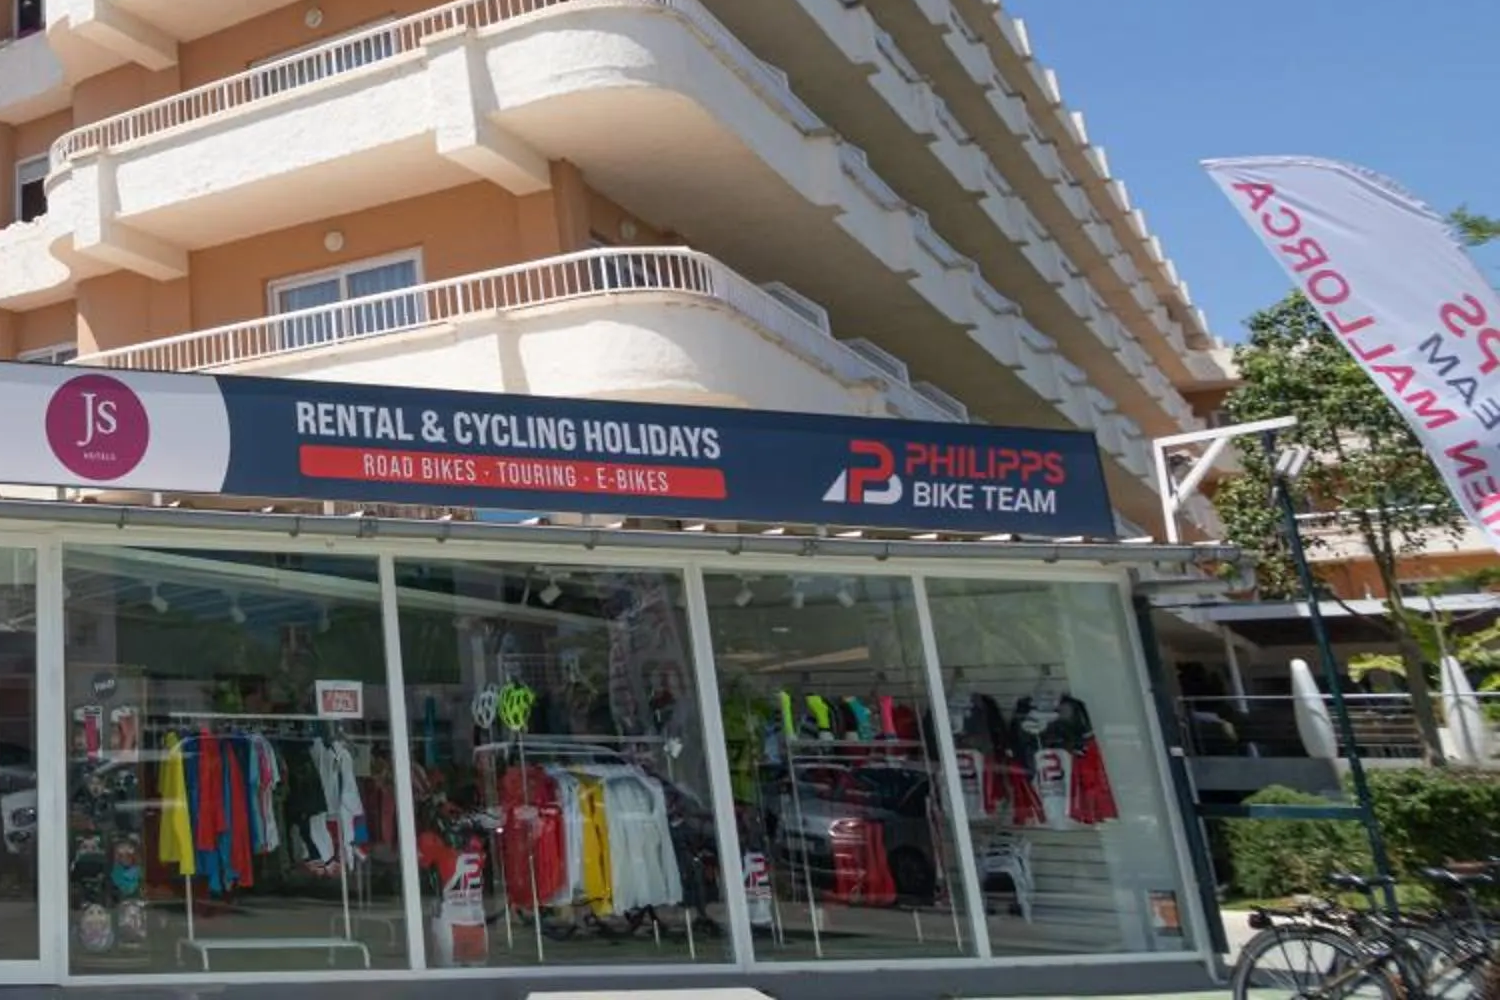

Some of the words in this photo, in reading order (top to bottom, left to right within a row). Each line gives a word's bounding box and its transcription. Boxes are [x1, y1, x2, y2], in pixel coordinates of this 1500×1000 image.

[295, 401, 414, 442] RENTAL
[421, 410, 447, 443] &
[452, 411, 577, 452] CYCLING
[584, 420, 722, 460] HOLIDAYS
[363, 454, 413, 479] ROAD
[421, 457, 477, 482] BIKES
[497, 461, 577, 488] TOURING
[596, 466, 669, 493] E-BIKES
[904, 442, 1067, 485] PHILIPPS
[912, 481, 974, 510] BIKE
[982, 485, 1057, 515] TEAM
